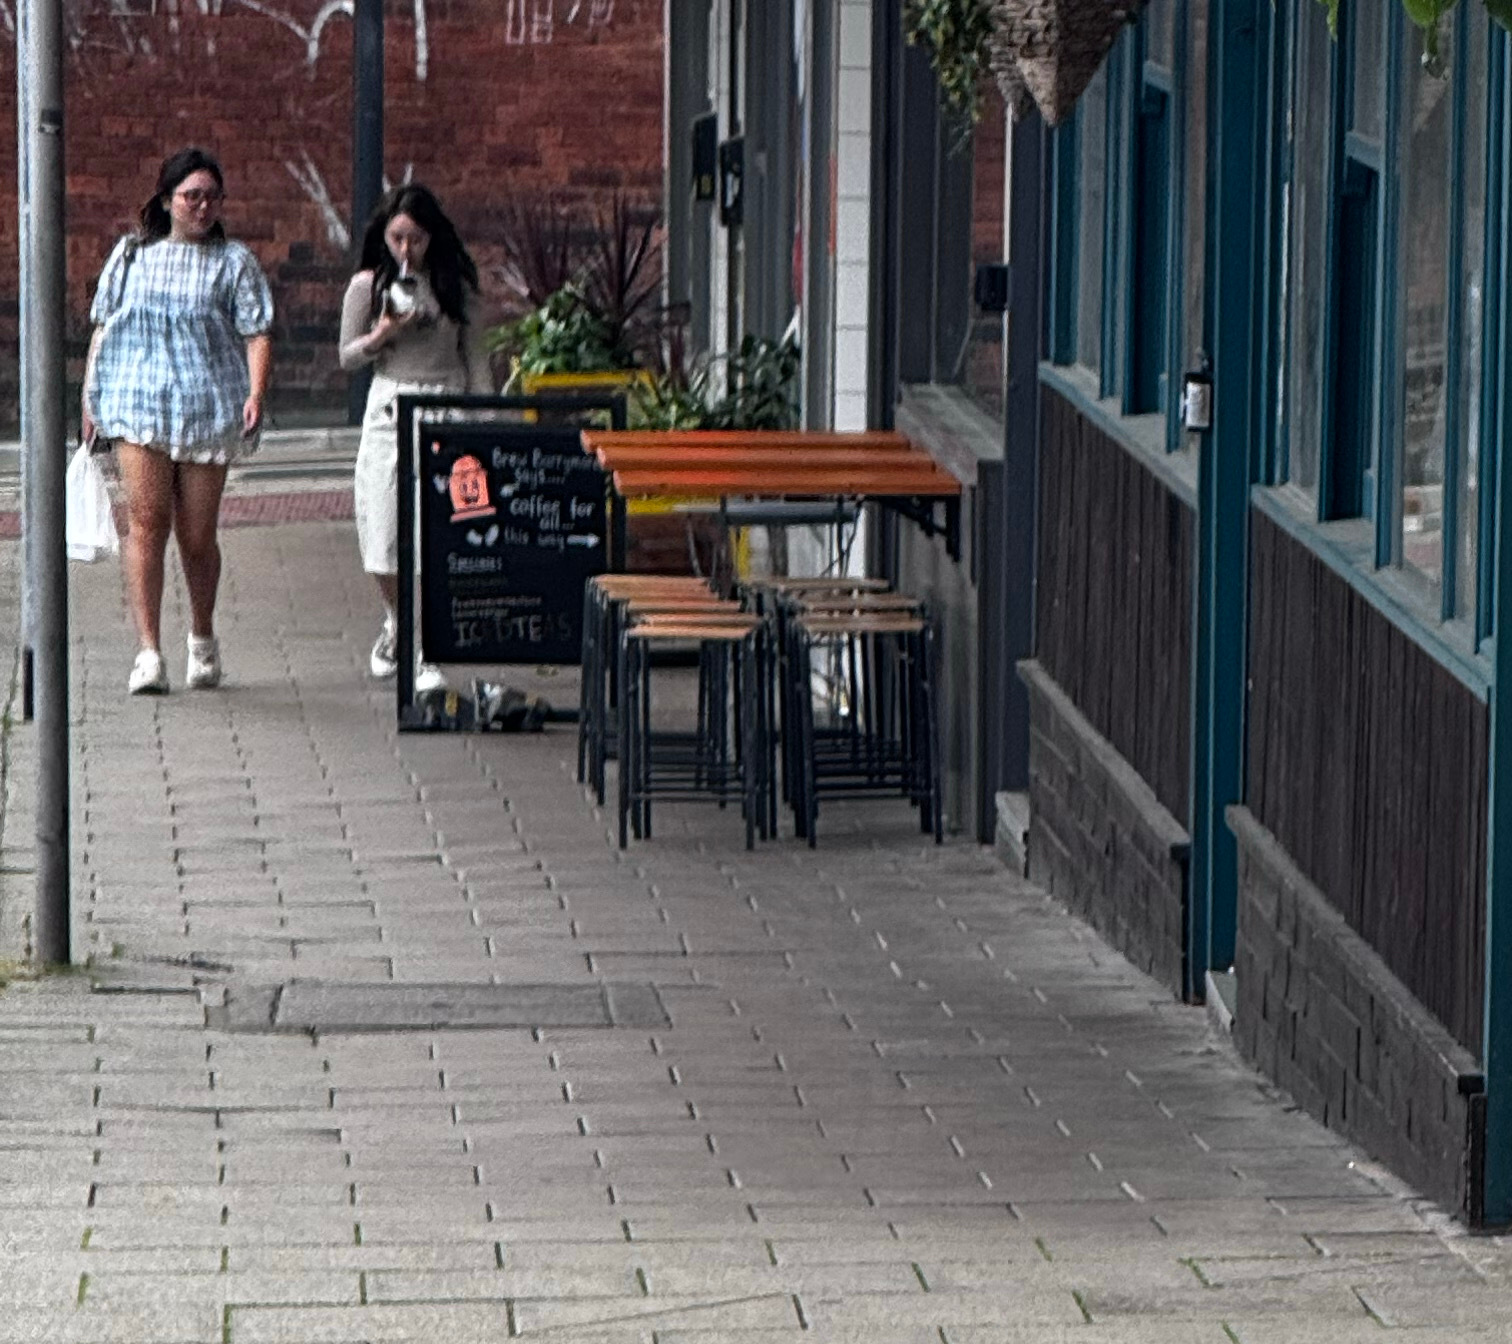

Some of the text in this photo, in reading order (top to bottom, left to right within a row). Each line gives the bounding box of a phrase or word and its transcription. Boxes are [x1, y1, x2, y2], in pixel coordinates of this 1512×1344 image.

[510, 494, 596, 519] coffee for
[504, 525, 565, 551] this way
